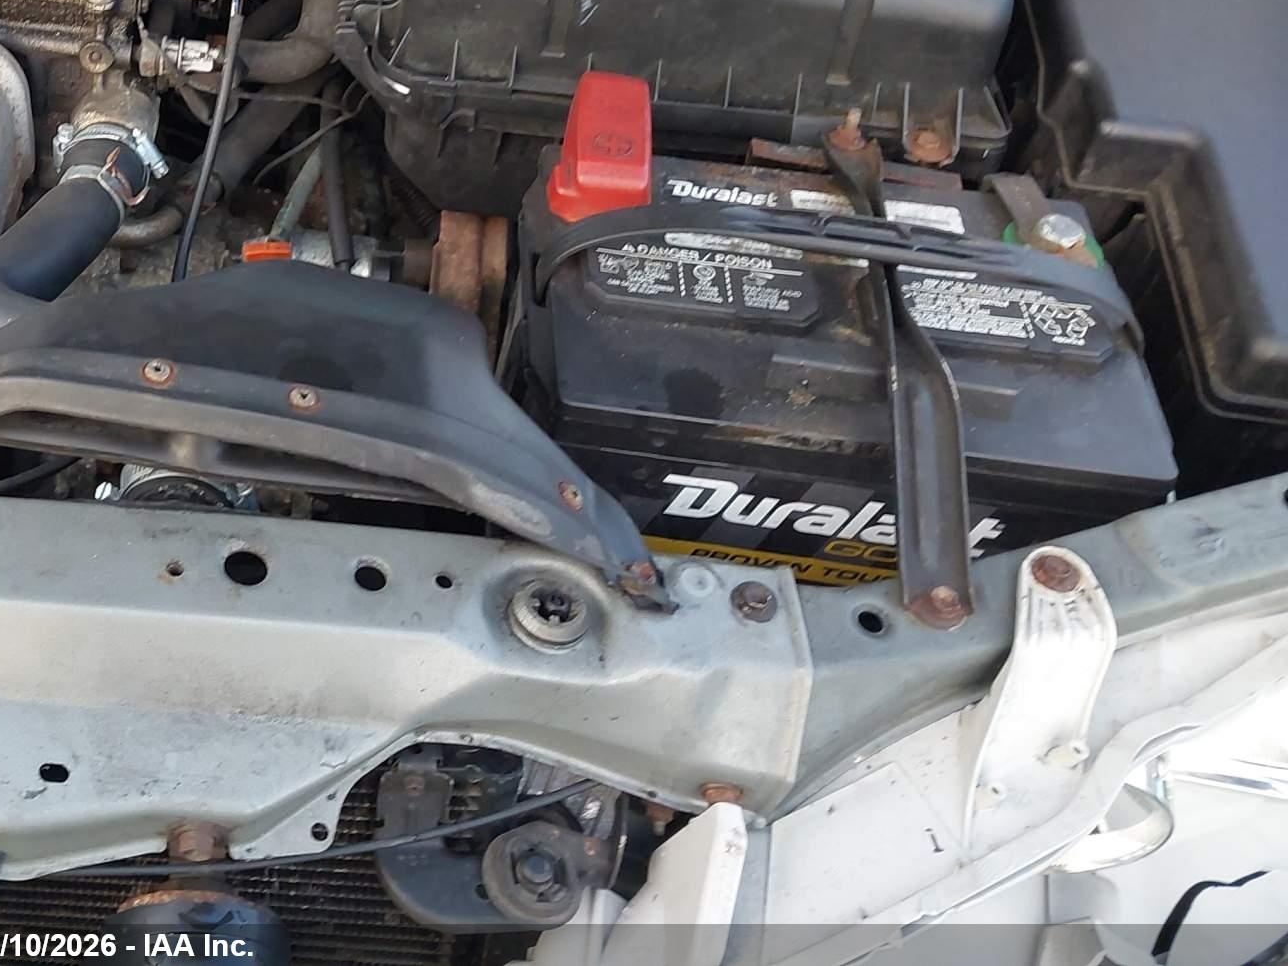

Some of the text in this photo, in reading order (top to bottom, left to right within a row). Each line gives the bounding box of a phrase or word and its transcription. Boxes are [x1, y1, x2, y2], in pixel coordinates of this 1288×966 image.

[667, 179, 778, 208] Duralast
[637, 244, 700, 261] DANGER
[715, 253, 773, 269] POISON
[663, 474, 1006, 558] Duralat
[823, 566, 896, 582] TOU
